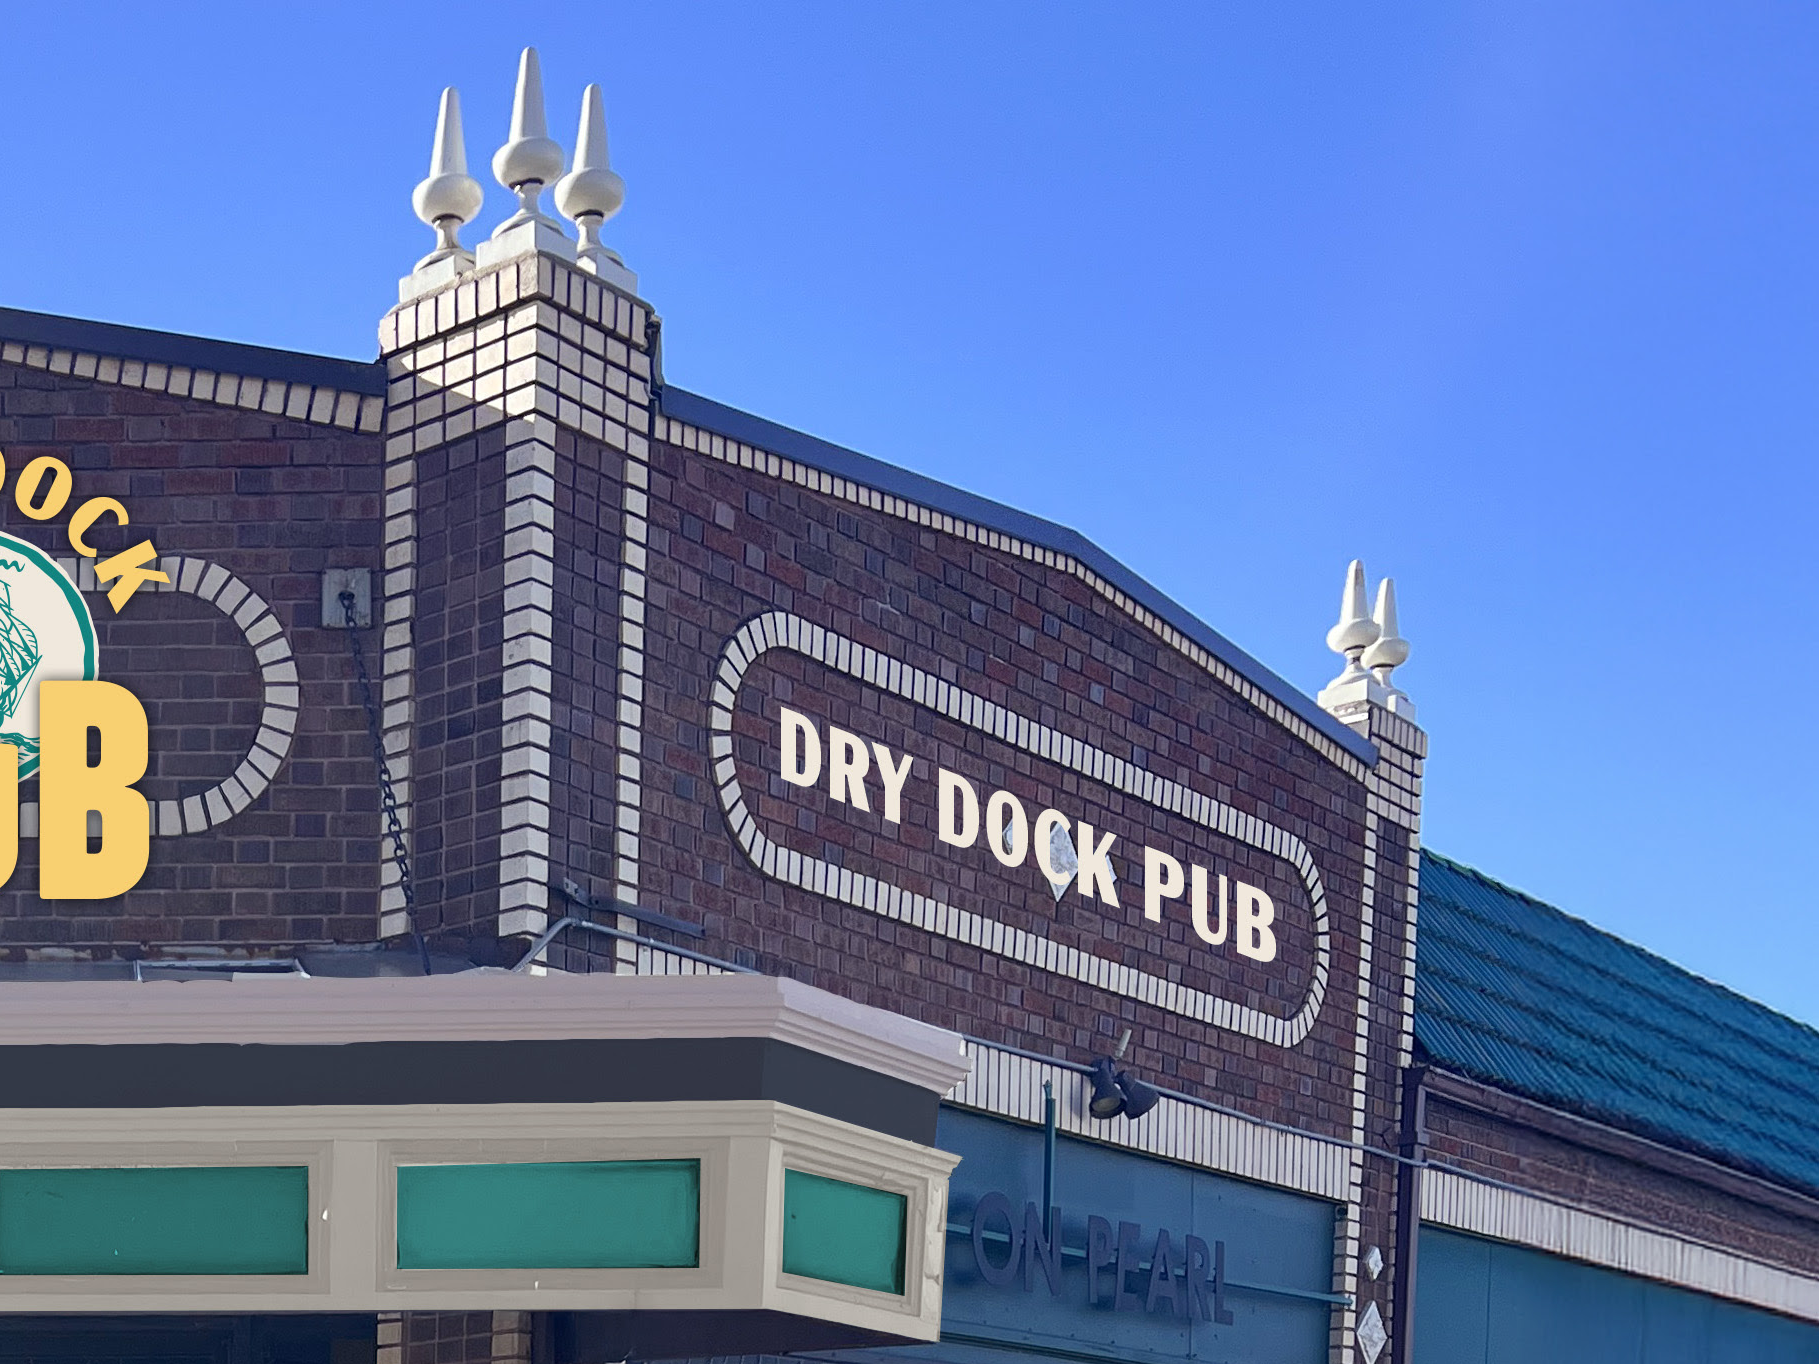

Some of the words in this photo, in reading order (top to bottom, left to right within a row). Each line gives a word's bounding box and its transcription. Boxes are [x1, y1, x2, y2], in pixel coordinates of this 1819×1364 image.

[780, 706, 914, 825] DRY
[937, 767, 1121, 909] DOCK
[1144, 847, 1277, 963] PUB
[971, 1191, 1062, 1296] ON
[1087, 1214, 1234, 1326] PEARL
